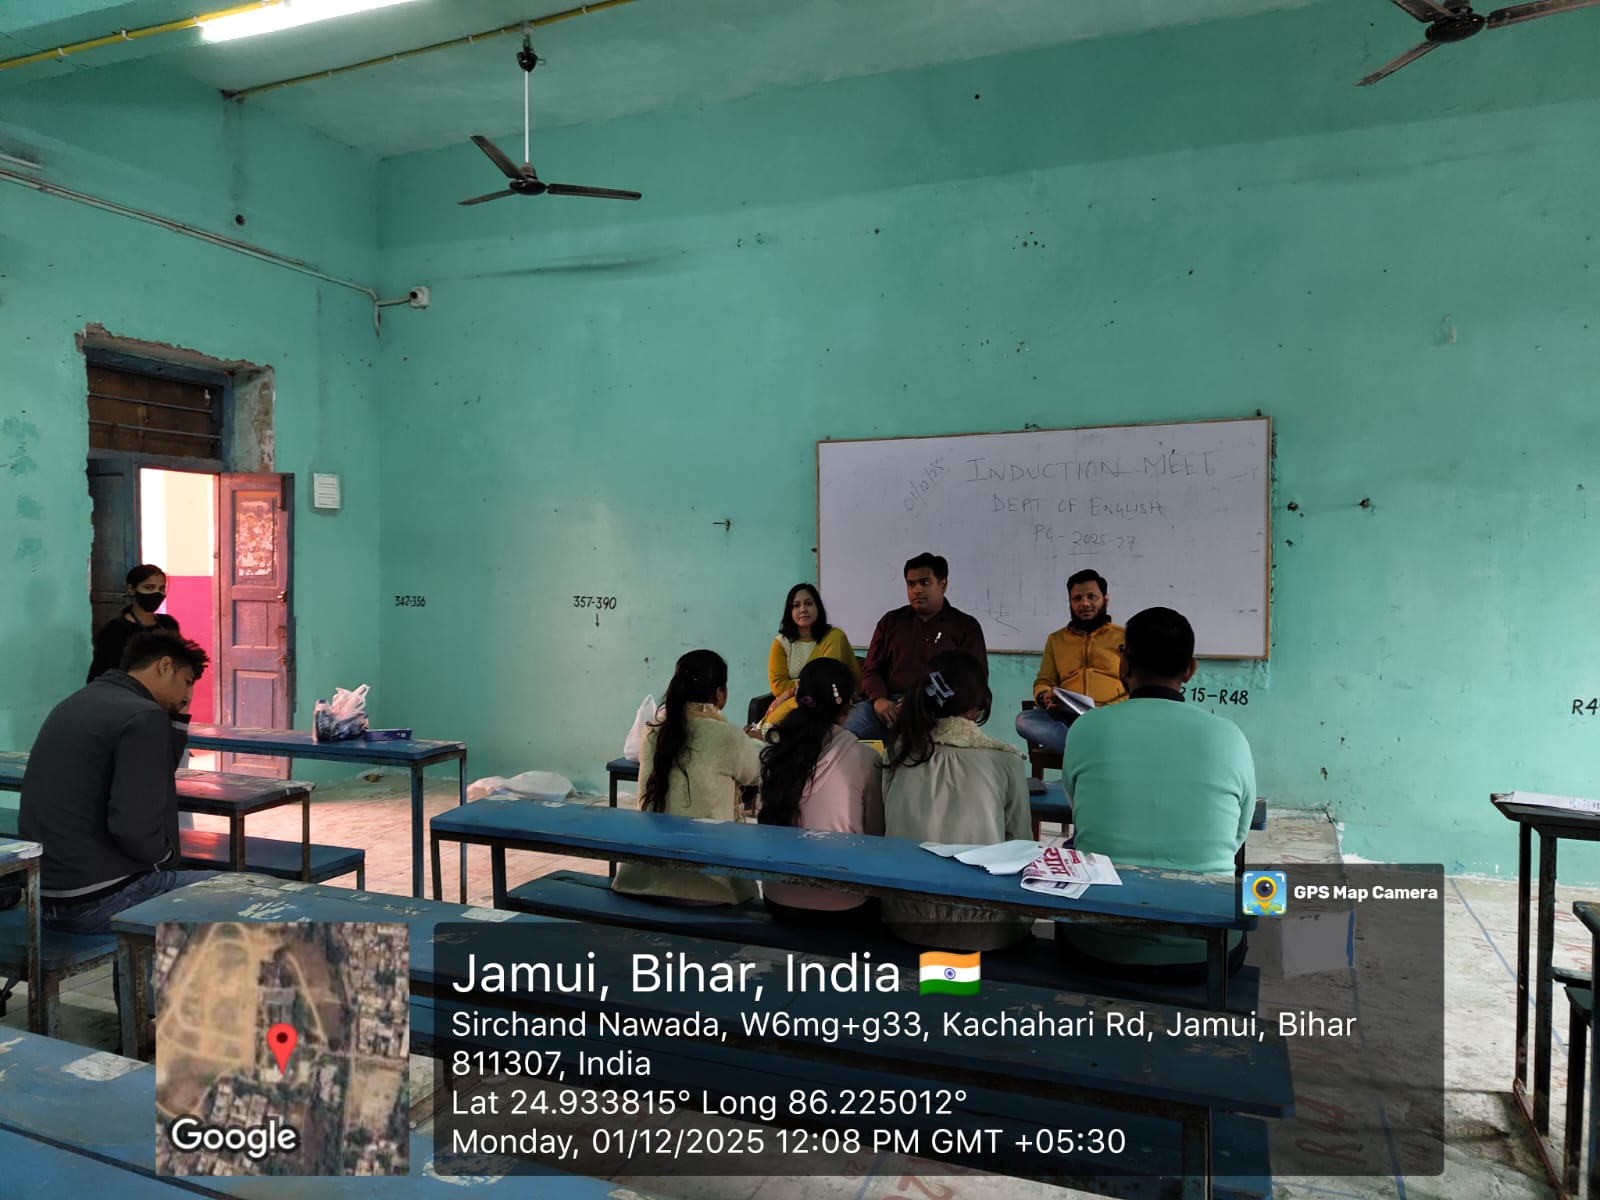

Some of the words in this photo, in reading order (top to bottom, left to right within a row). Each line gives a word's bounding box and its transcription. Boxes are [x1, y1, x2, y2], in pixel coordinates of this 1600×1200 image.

[966, 458, 1120, 482] INDUCTION
[1143, 450, 1222, 477] MEET
[992, 494, 1045, 512] DEPT
[1058, 499, 1079, 513] OF
[394, 596, 426, 608] 342-356
[573, 595, 617, 610] 357-390
[1571, 697, 1600, 716] R4
